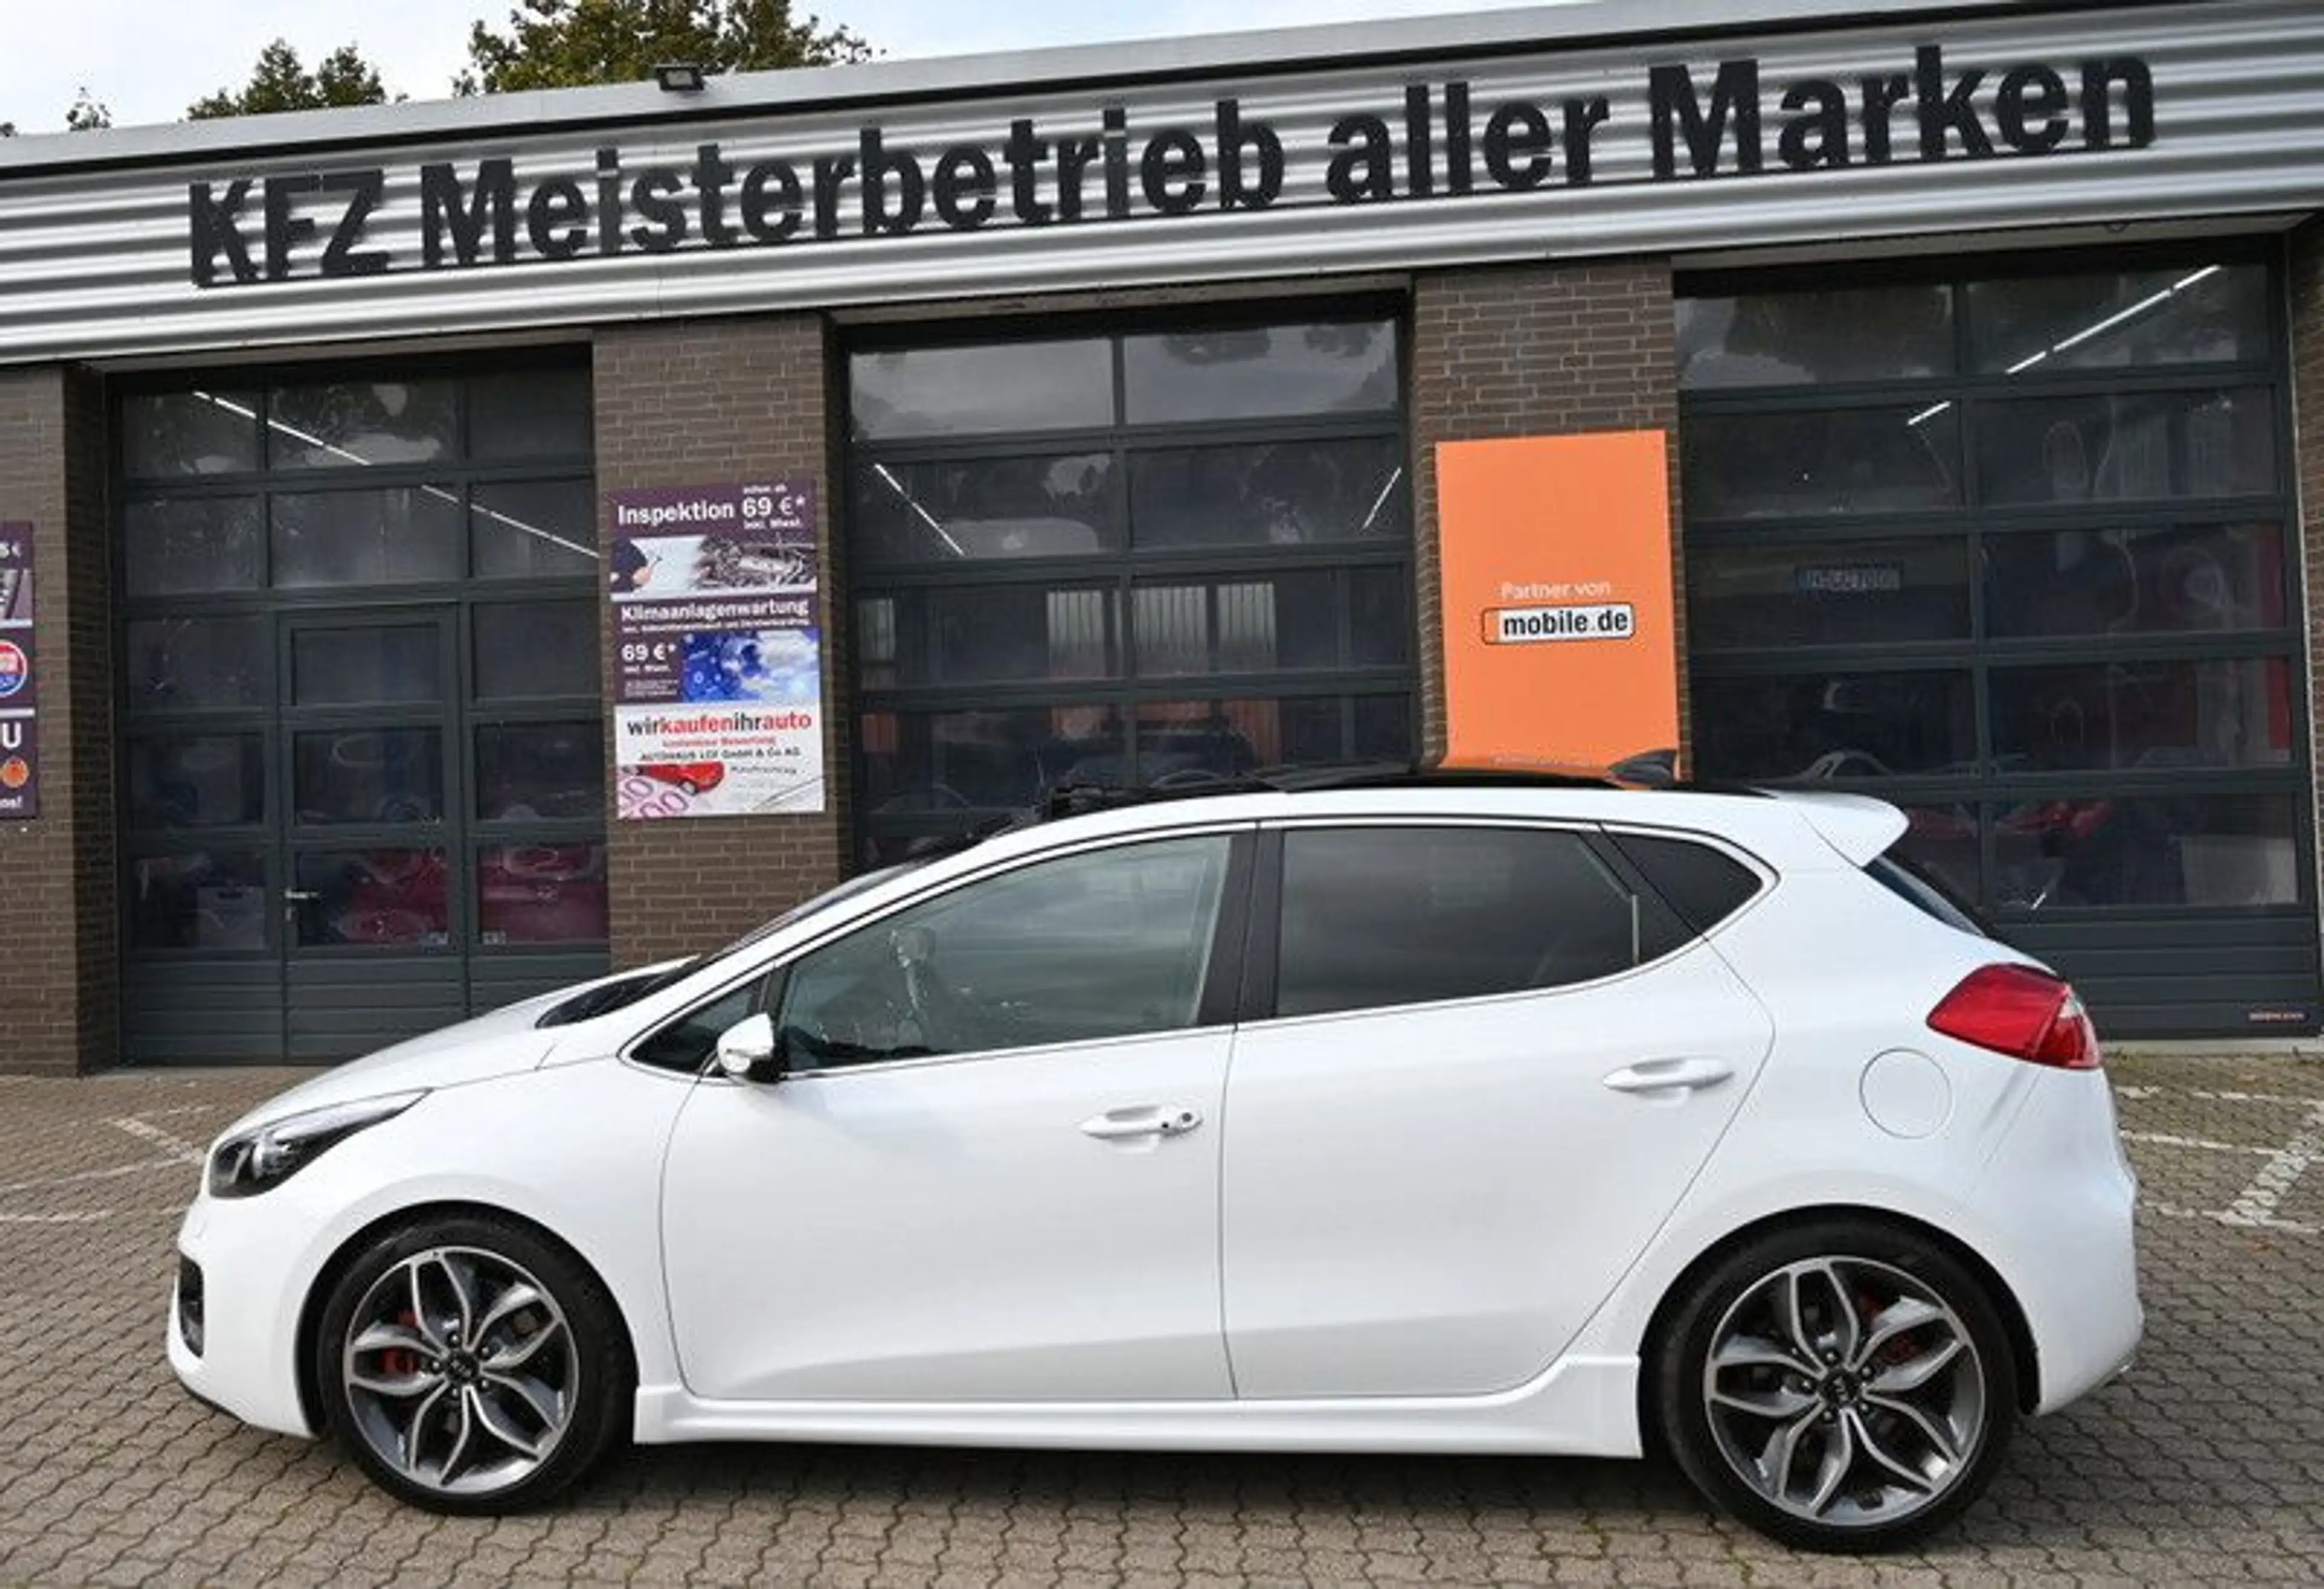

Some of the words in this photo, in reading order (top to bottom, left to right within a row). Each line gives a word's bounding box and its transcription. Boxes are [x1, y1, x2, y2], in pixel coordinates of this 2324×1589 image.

[189, 169, 388, 285] KFZ
[421, 99, 1284, 268] Meisterbetrieb
[1326, 81, 1609, 202] aller
[1649, 45, 2155, 179] Marken
[619, 501, 734, 526] Inspektion
[742, 496, 772, 518] 69
[1501, 583, 1571, 599] Partner
[1574, 581, 1611, 596] von
[621, 599, 809, 621] Klimaanlagenwartung
[1503, 610, 1628, 636] mobile.de
[622, 643, 648, 662] 69
[627, 711, 812, 735] wirkaufenihrauto
